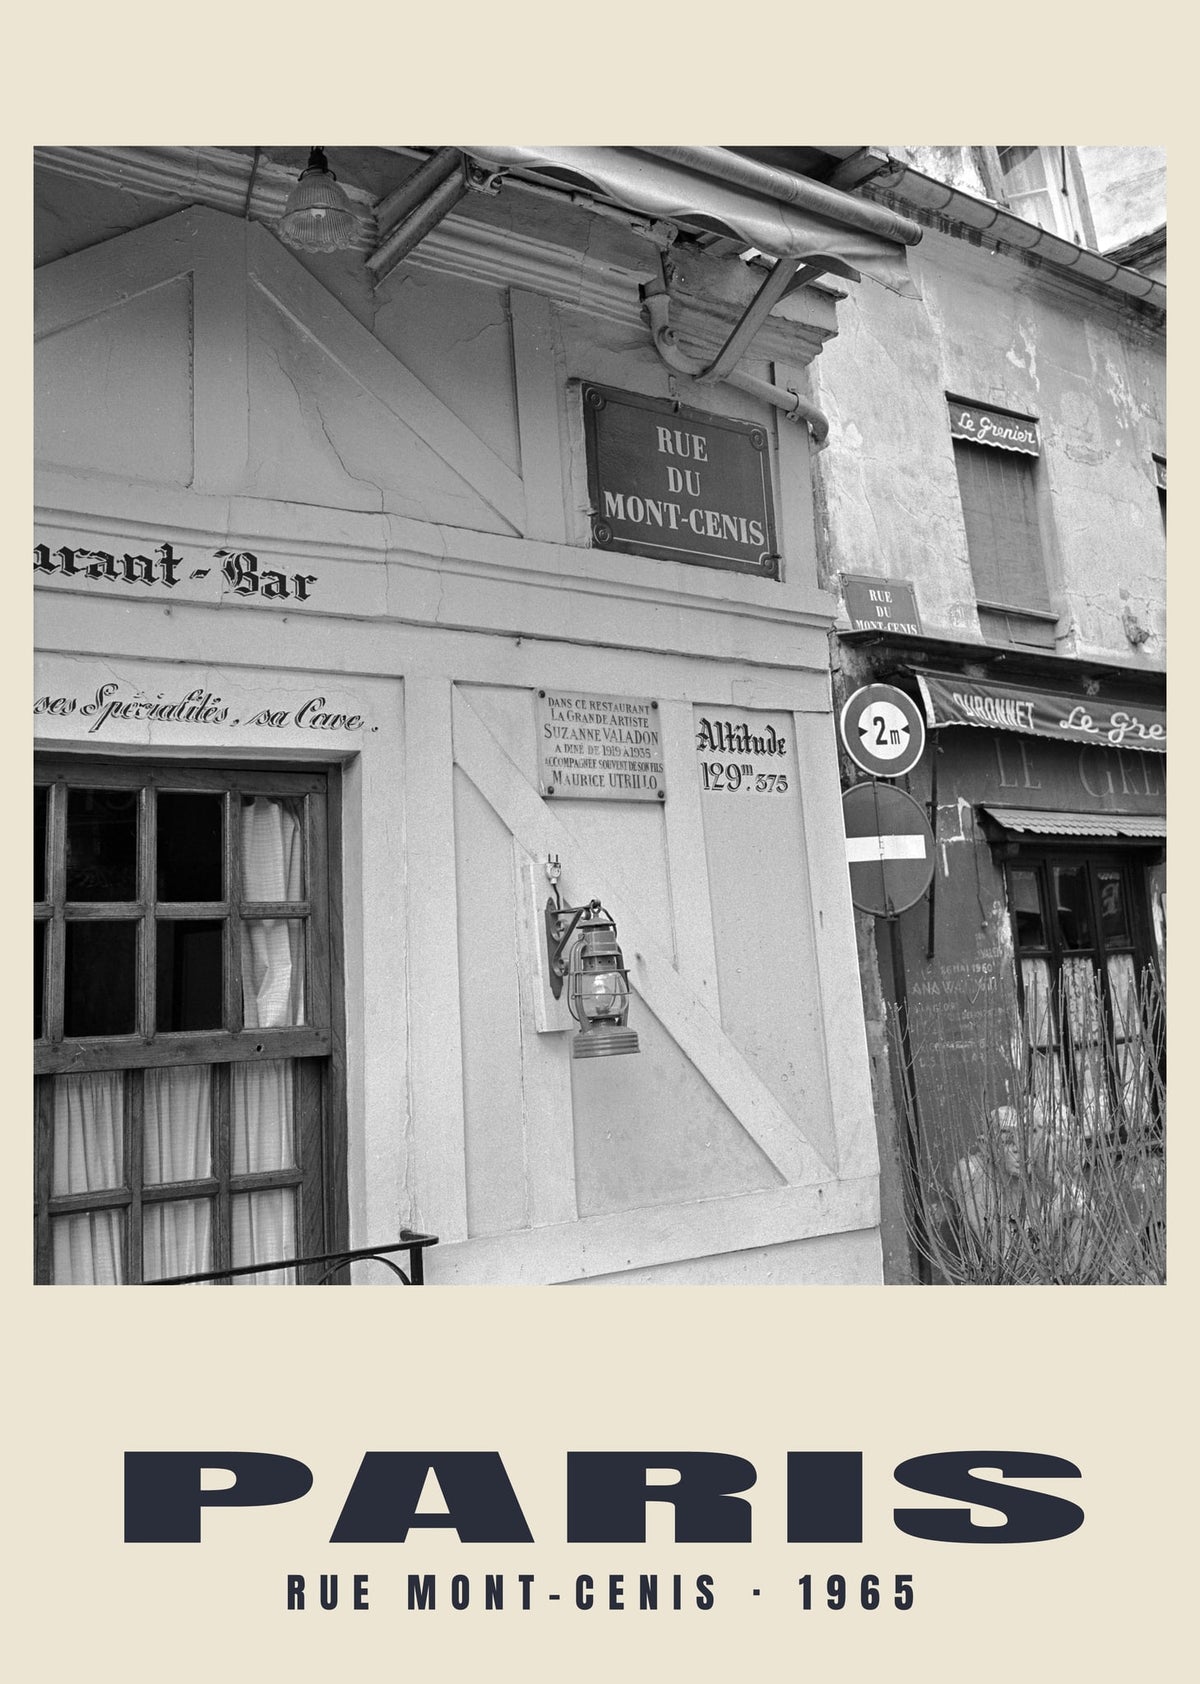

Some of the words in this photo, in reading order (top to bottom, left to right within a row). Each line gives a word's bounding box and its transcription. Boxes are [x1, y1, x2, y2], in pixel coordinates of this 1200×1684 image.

[957, 412, 975, 432] Le
[977, 416, 1036, 444] Grenier
[656, 426, 708, 462] RUE
[666, 466, 701, 497] DU
[603, 490, 765, 547] MONT-CENIS
[869, 589, 893, 603] RUE
[875, 605, 892, 618] DU
[547, 697, 573, 708] DANS
[575, 699, 587, 709] CE
[589, 700, 650, 714] RESTAURANT
[243, 709, 292, 728] sa
[551, 707, 565, 721] LA
[566, 709, 608, 724] GRANDE
[609, 714, 649, 728] ARTISTE
[1059, 706, 1099, 733] Le
[543, 723, 602, 741] SUZANNE
[602, 727, 660, 745] VALADON
[695, 717, 787, 758] Altitude
[588, 745, 600, 755] DE
[602, 744, 621, 756] 1919
[630, 747, 652, 758] 1935
[598, 759, 628, 771] SOUVENT
[995, 737, 1042, 789] LE
[1079, 748, 1166, 798] GRE
[552, 770, 605, 786] MAURICE
